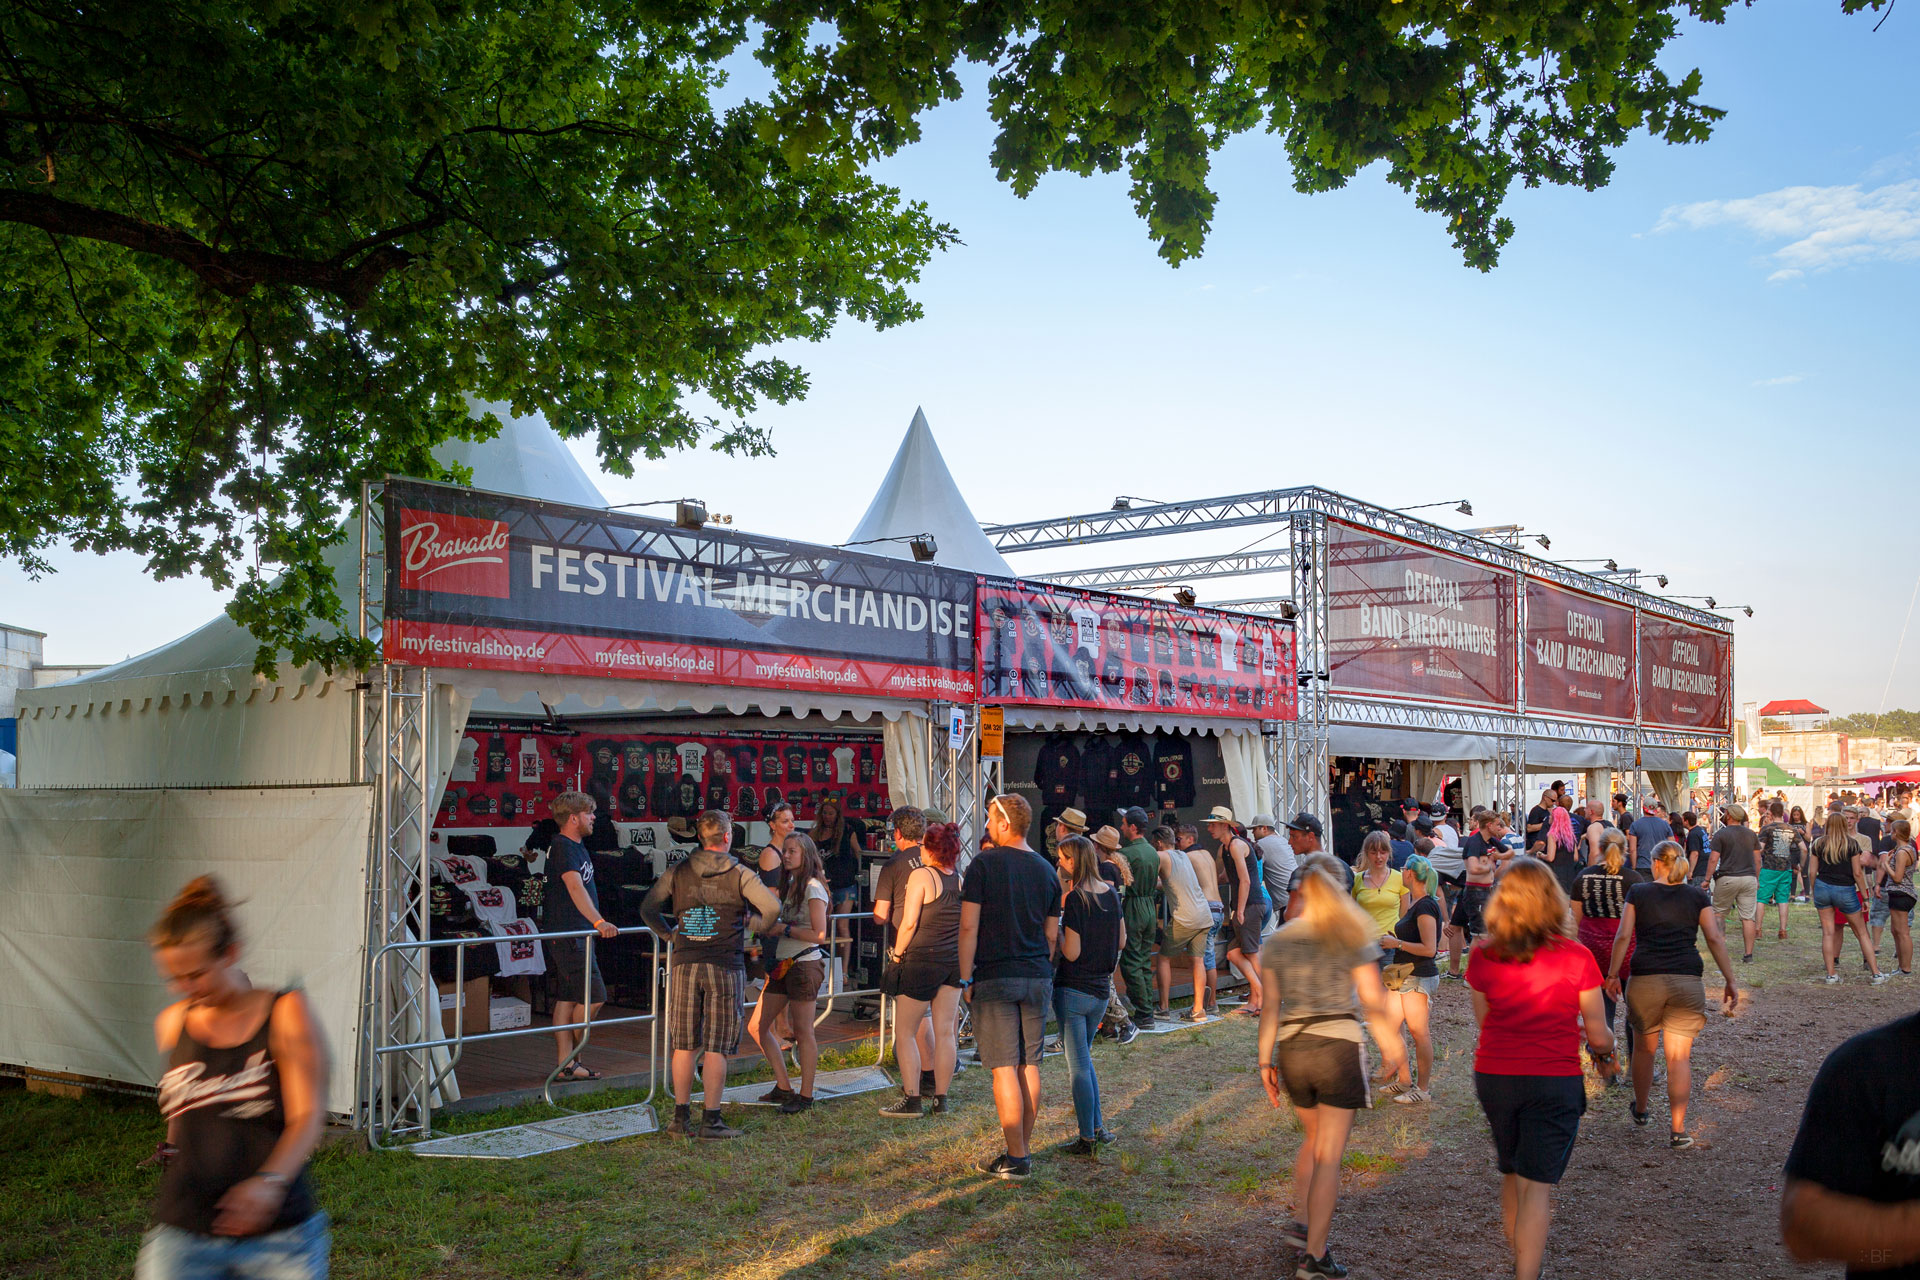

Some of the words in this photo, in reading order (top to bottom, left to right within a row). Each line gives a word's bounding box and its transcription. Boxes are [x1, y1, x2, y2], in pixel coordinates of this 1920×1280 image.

[401, 521, 509, 571] Bravado
[531, 545, 723, 609] FESTIVAL
[735, 571, 969, 638] MERCHANDISE
[1405, 569, 1463, 611] OFFICIAL
[1360, 602, 1402, 640] BAND
[1408, 611, 1497, 657] MERCHANDISE
[1567, 609, 1604, 644] OFFICIAL
[402, 634, 545, 660] myfestivalshop.de
[595, 649, 714, 673] myfestivalshop.de
[756, 663, 857, 684] myfestivalshop.de
[891, 674, 974, 694] myfestivalshop.de
[1536, 638, 1563, 668] BAND
[1567, 644, 1626, 681] MERCHANDISE
[1671, 639, 1699, 666] OFFICIAL
[1652, 664, 1671, 689] BAND
[1672, 668, 1717, 697] MERCHANDISE
